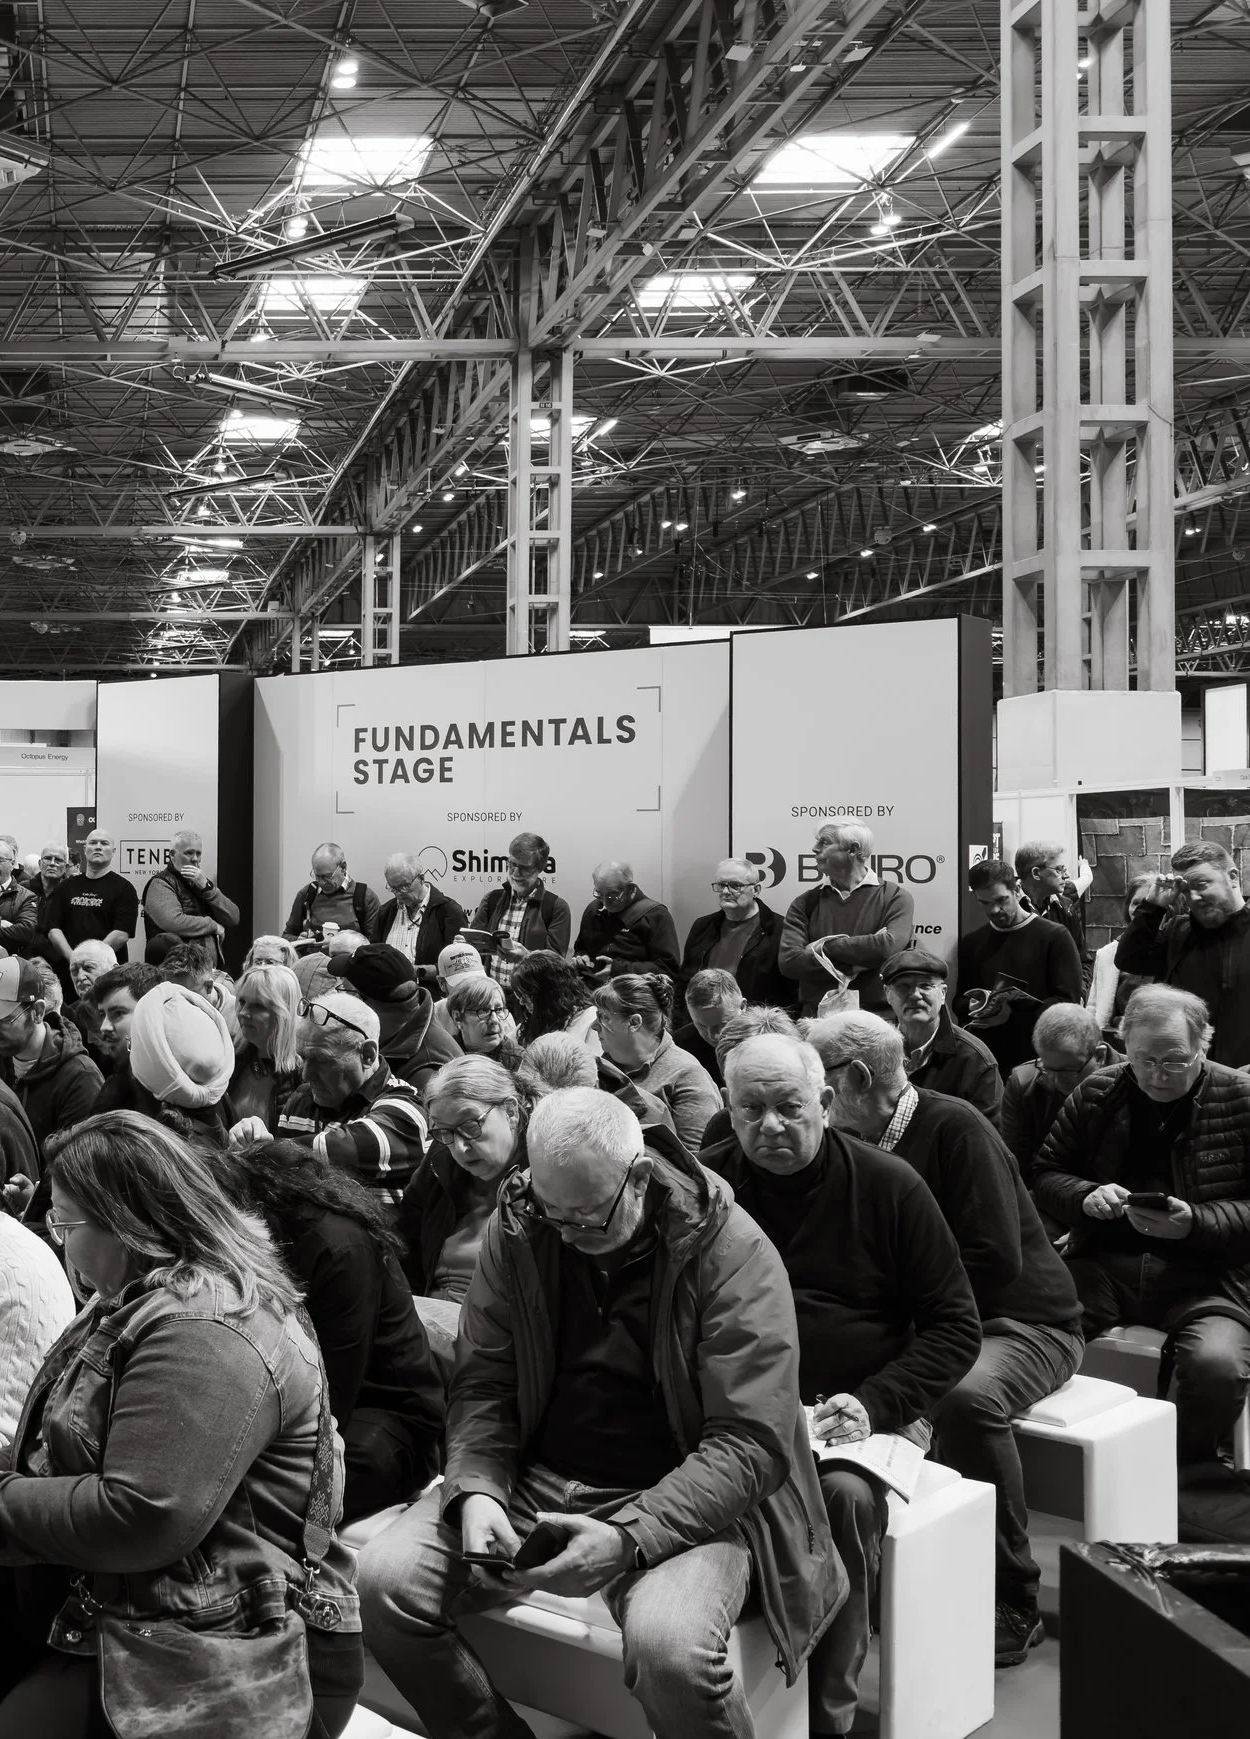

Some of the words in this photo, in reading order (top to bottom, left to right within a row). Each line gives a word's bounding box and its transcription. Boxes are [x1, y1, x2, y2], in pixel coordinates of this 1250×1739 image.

[353, 714, 637, 753] FUNDAMENTALS
[20, 752, 46, 760] Octopus
[47, 753, 69, 761] Energy
[353, 756, 454, 785] STAGE
[128, 812, 173, 822] SPONSORED
[174, 812, 184, 822] BY
[446, 812, 507, 822] SPONSORED
[509, 812, 523, 821] BY
[791, 805, 873, 818] SPONSORED
[877, 805, 895, 817] BY
[126, 848, 170, 865] TENB
[452, 849, 556, 874] Shima
[453, 875, 509, 883] EXPLOR
